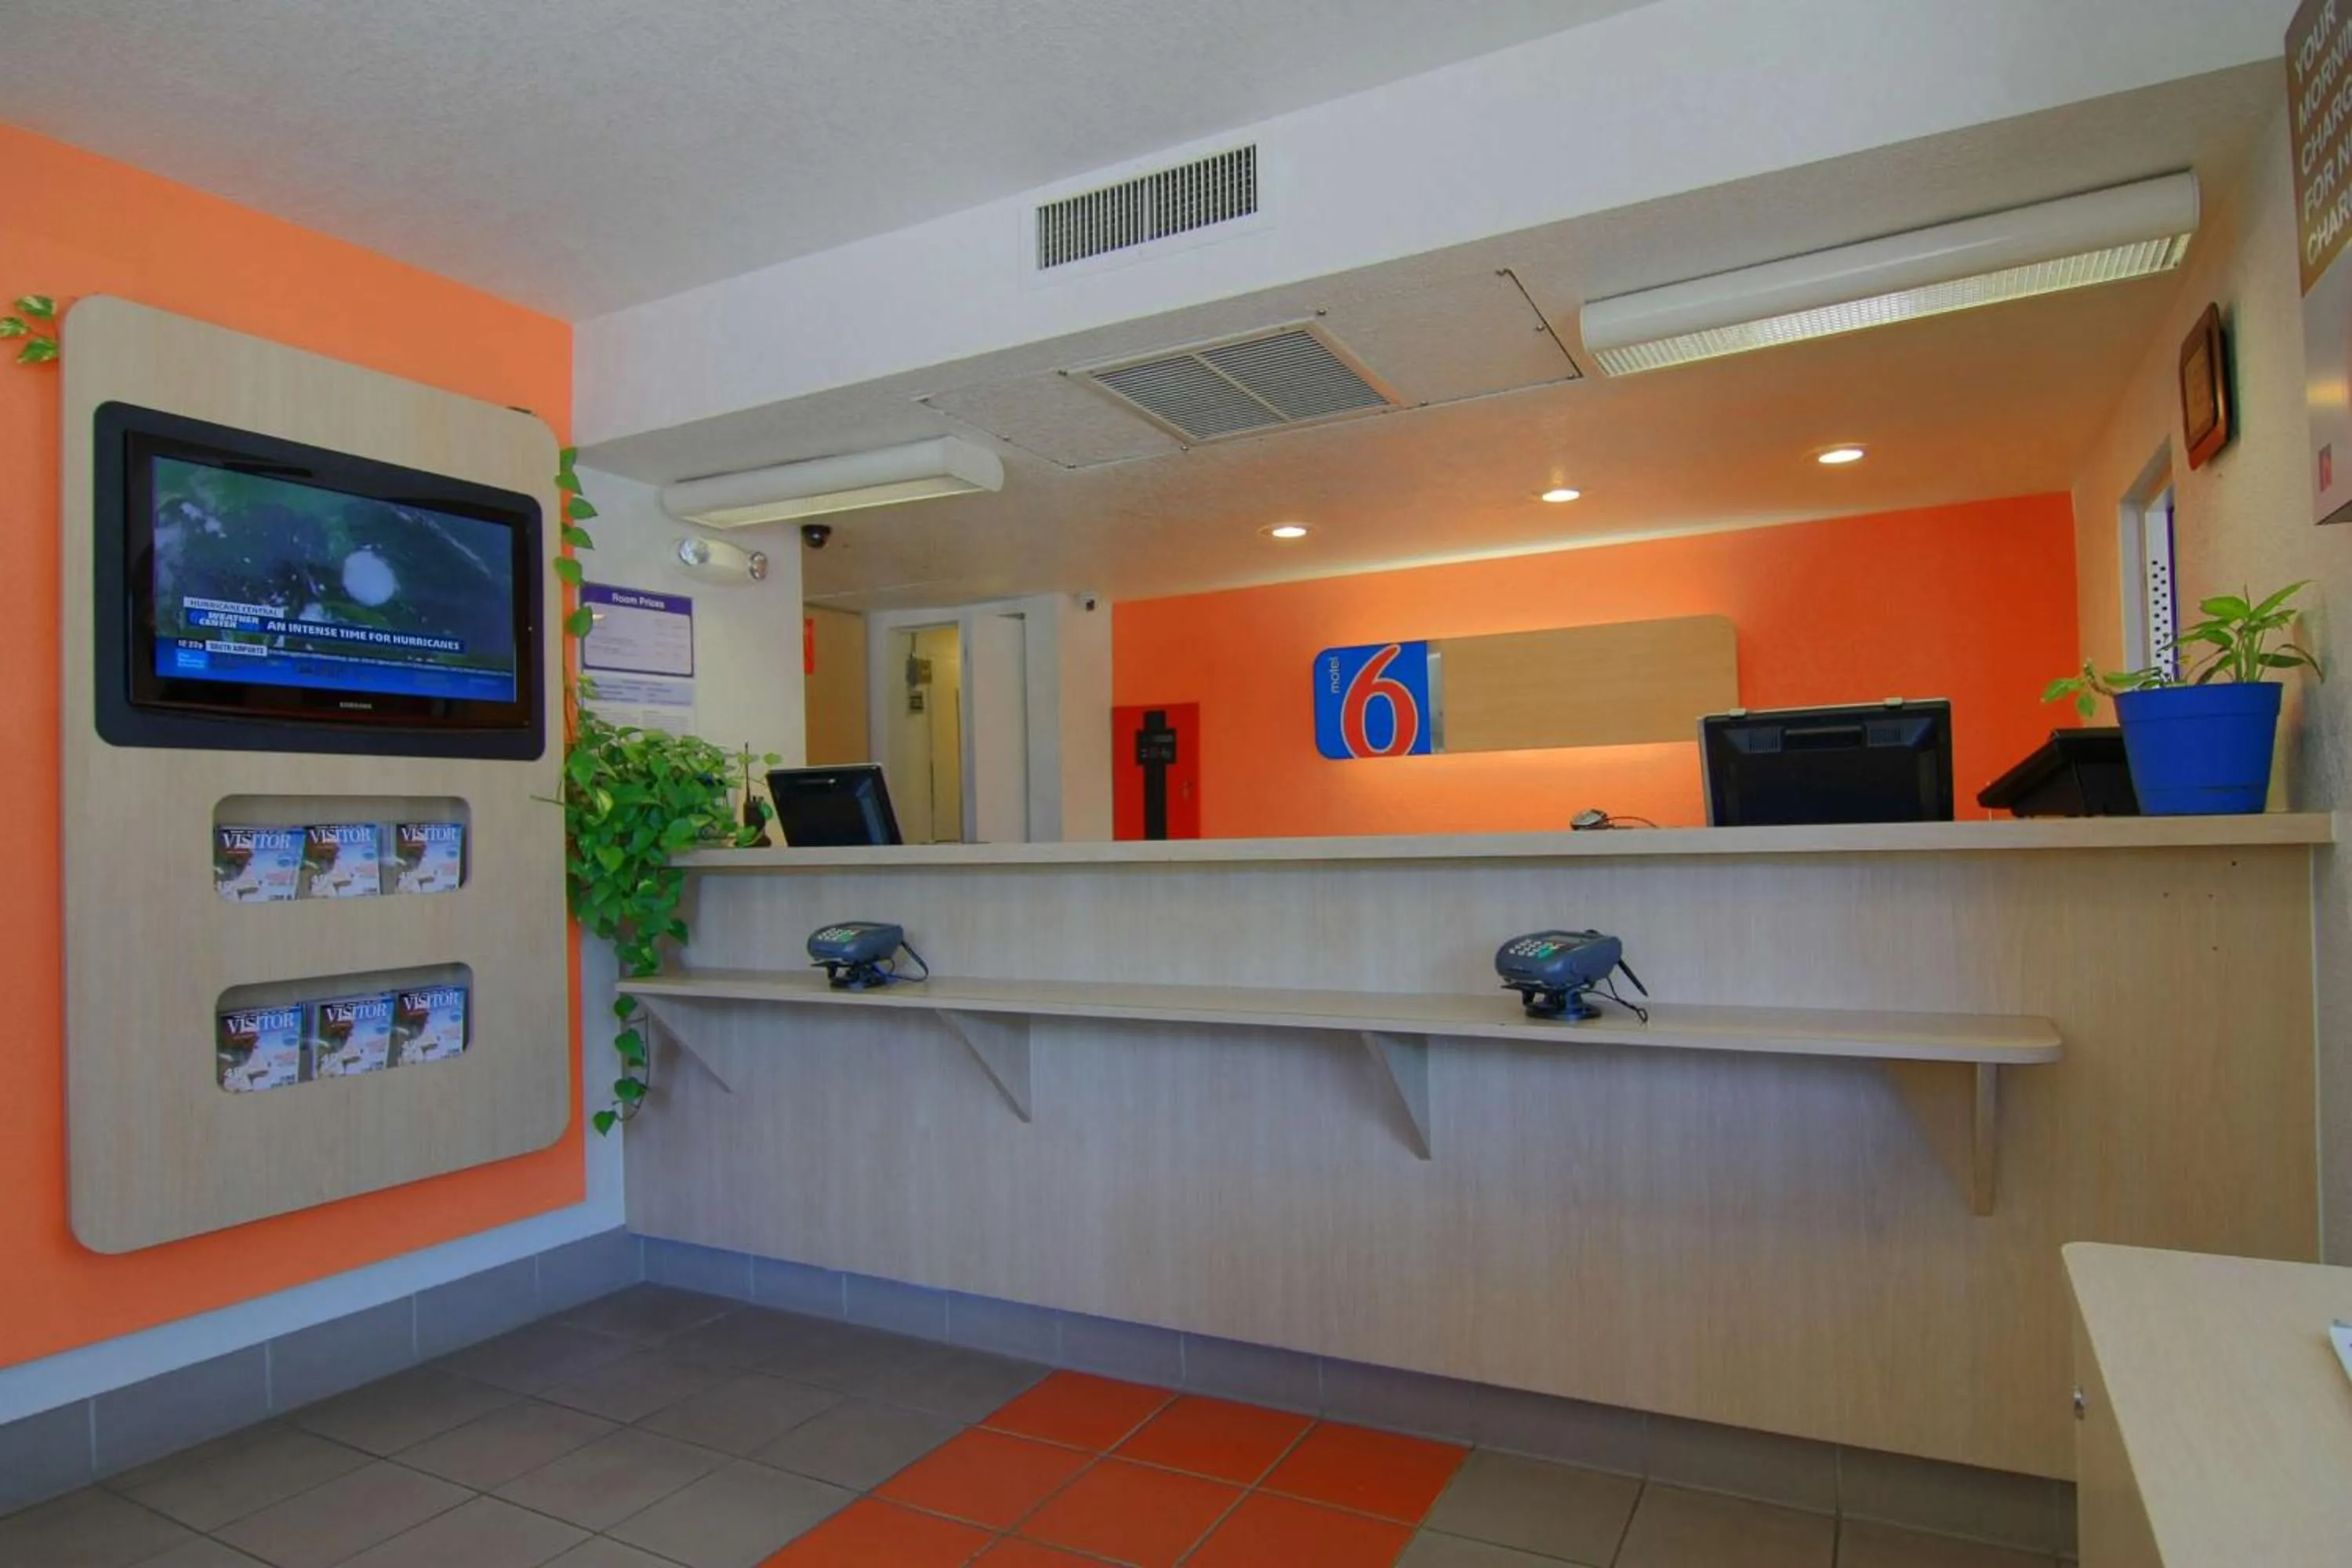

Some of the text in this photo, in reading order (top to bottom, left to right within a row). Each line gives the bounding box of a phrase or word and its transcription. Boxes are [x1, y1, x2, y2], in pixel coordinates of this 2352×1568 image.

[2296, 0, 2337, 83] YOUR
[2304, 125, 2352, 225] FOR N
[612, 592, 665, 609] Room Prices
[198, 617, 238, 628] CENTER
[208, 612, 260, 625] WEATHER
[267, 621, 459, 651] AN INTENSE TIME FOR HURRICANES
[1328, 656, 1341, 694] motel
[1341, 644, 1418, 759] 6
[223, 833, 291, 849] VISITOR
[310, 826, 371, 844] VISITOR
[401, 826, 456, 843] VISITOR
[404, 990, 459, 1011] VISITOR
[326, 1003, 387, 1023] VISITOR
[227, 1012, 295, 1035] VISITOR
